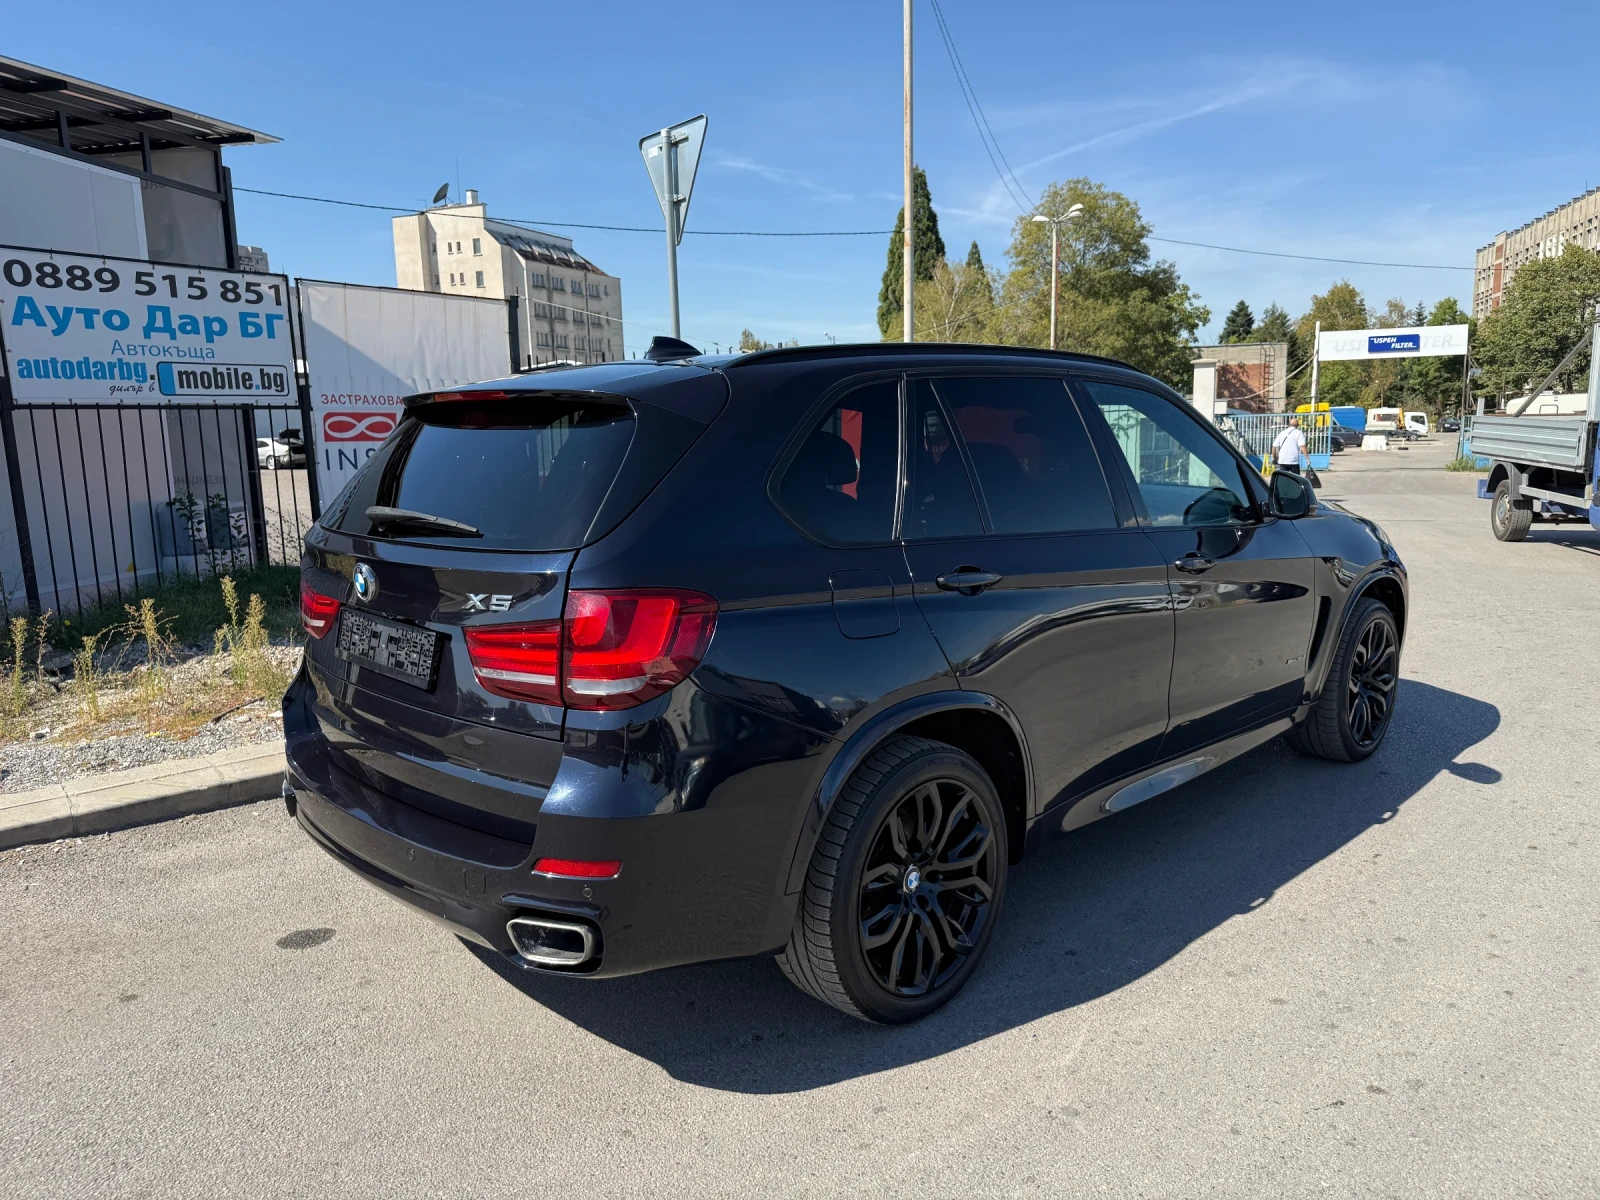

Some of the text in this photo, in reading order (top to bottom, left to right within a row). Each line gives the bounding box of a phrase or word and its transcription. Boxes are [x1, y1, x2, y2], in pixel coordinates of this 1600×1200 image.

[3, 259, 283, 306] 0889 515 851
[11, 295, 284, 343] Ауто Дар БГ
[110, 339, 215, 360] Автокъща
[1374, 336, 1397, 344] USPEH
[177, 367, 285, 393] mobile.bg
[321, 394, 405, 406] ЗАСТРАХОВА
[462, 593, 514, 612] X5
